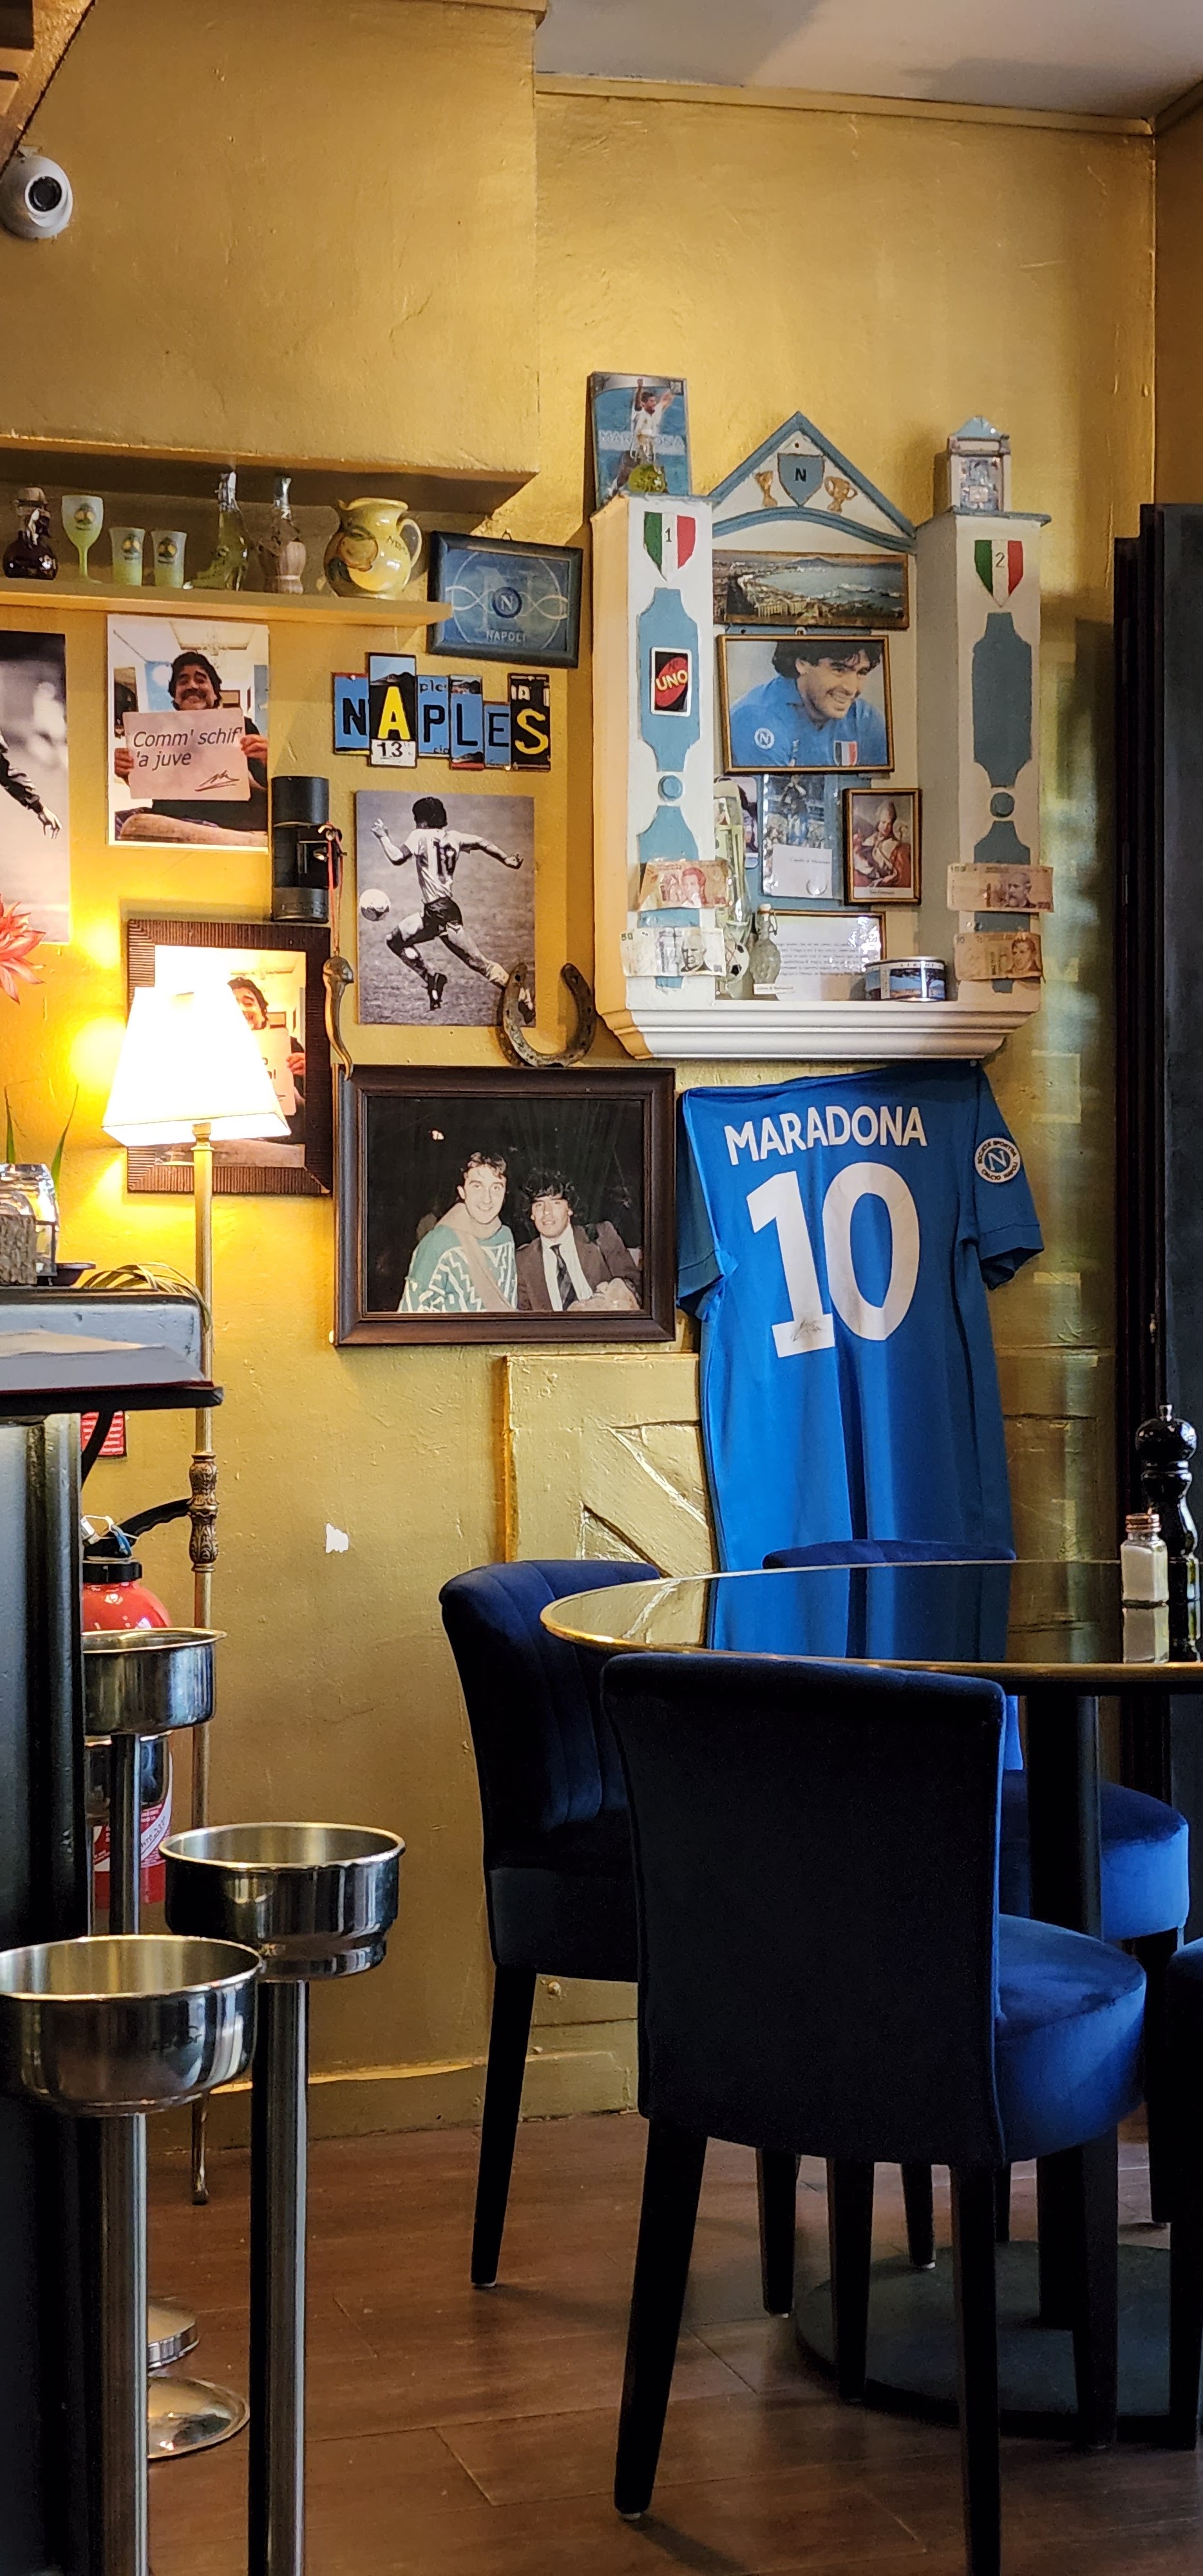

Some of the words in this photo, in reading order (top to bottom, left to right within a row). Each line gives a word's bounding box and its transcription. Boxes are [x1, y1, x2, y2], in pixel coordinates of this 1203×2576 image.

[795, 468, 807, 482] N
[665, 527, 672, 542] 1
[995, 552, 1005, 567] 2
[486, 630, 527, 642] NAPOLI
[656, 669, 688, 691] UNO
[133, 729, 194, 748] Comm'
[377, 741, 403, 757] 13
[152, 751, 192, 771] juve
[724, 1106, 927, 1166] MARADONA
[988, 1150, 1007, 1171] N
[746, 1162, 920, 1358] 10
